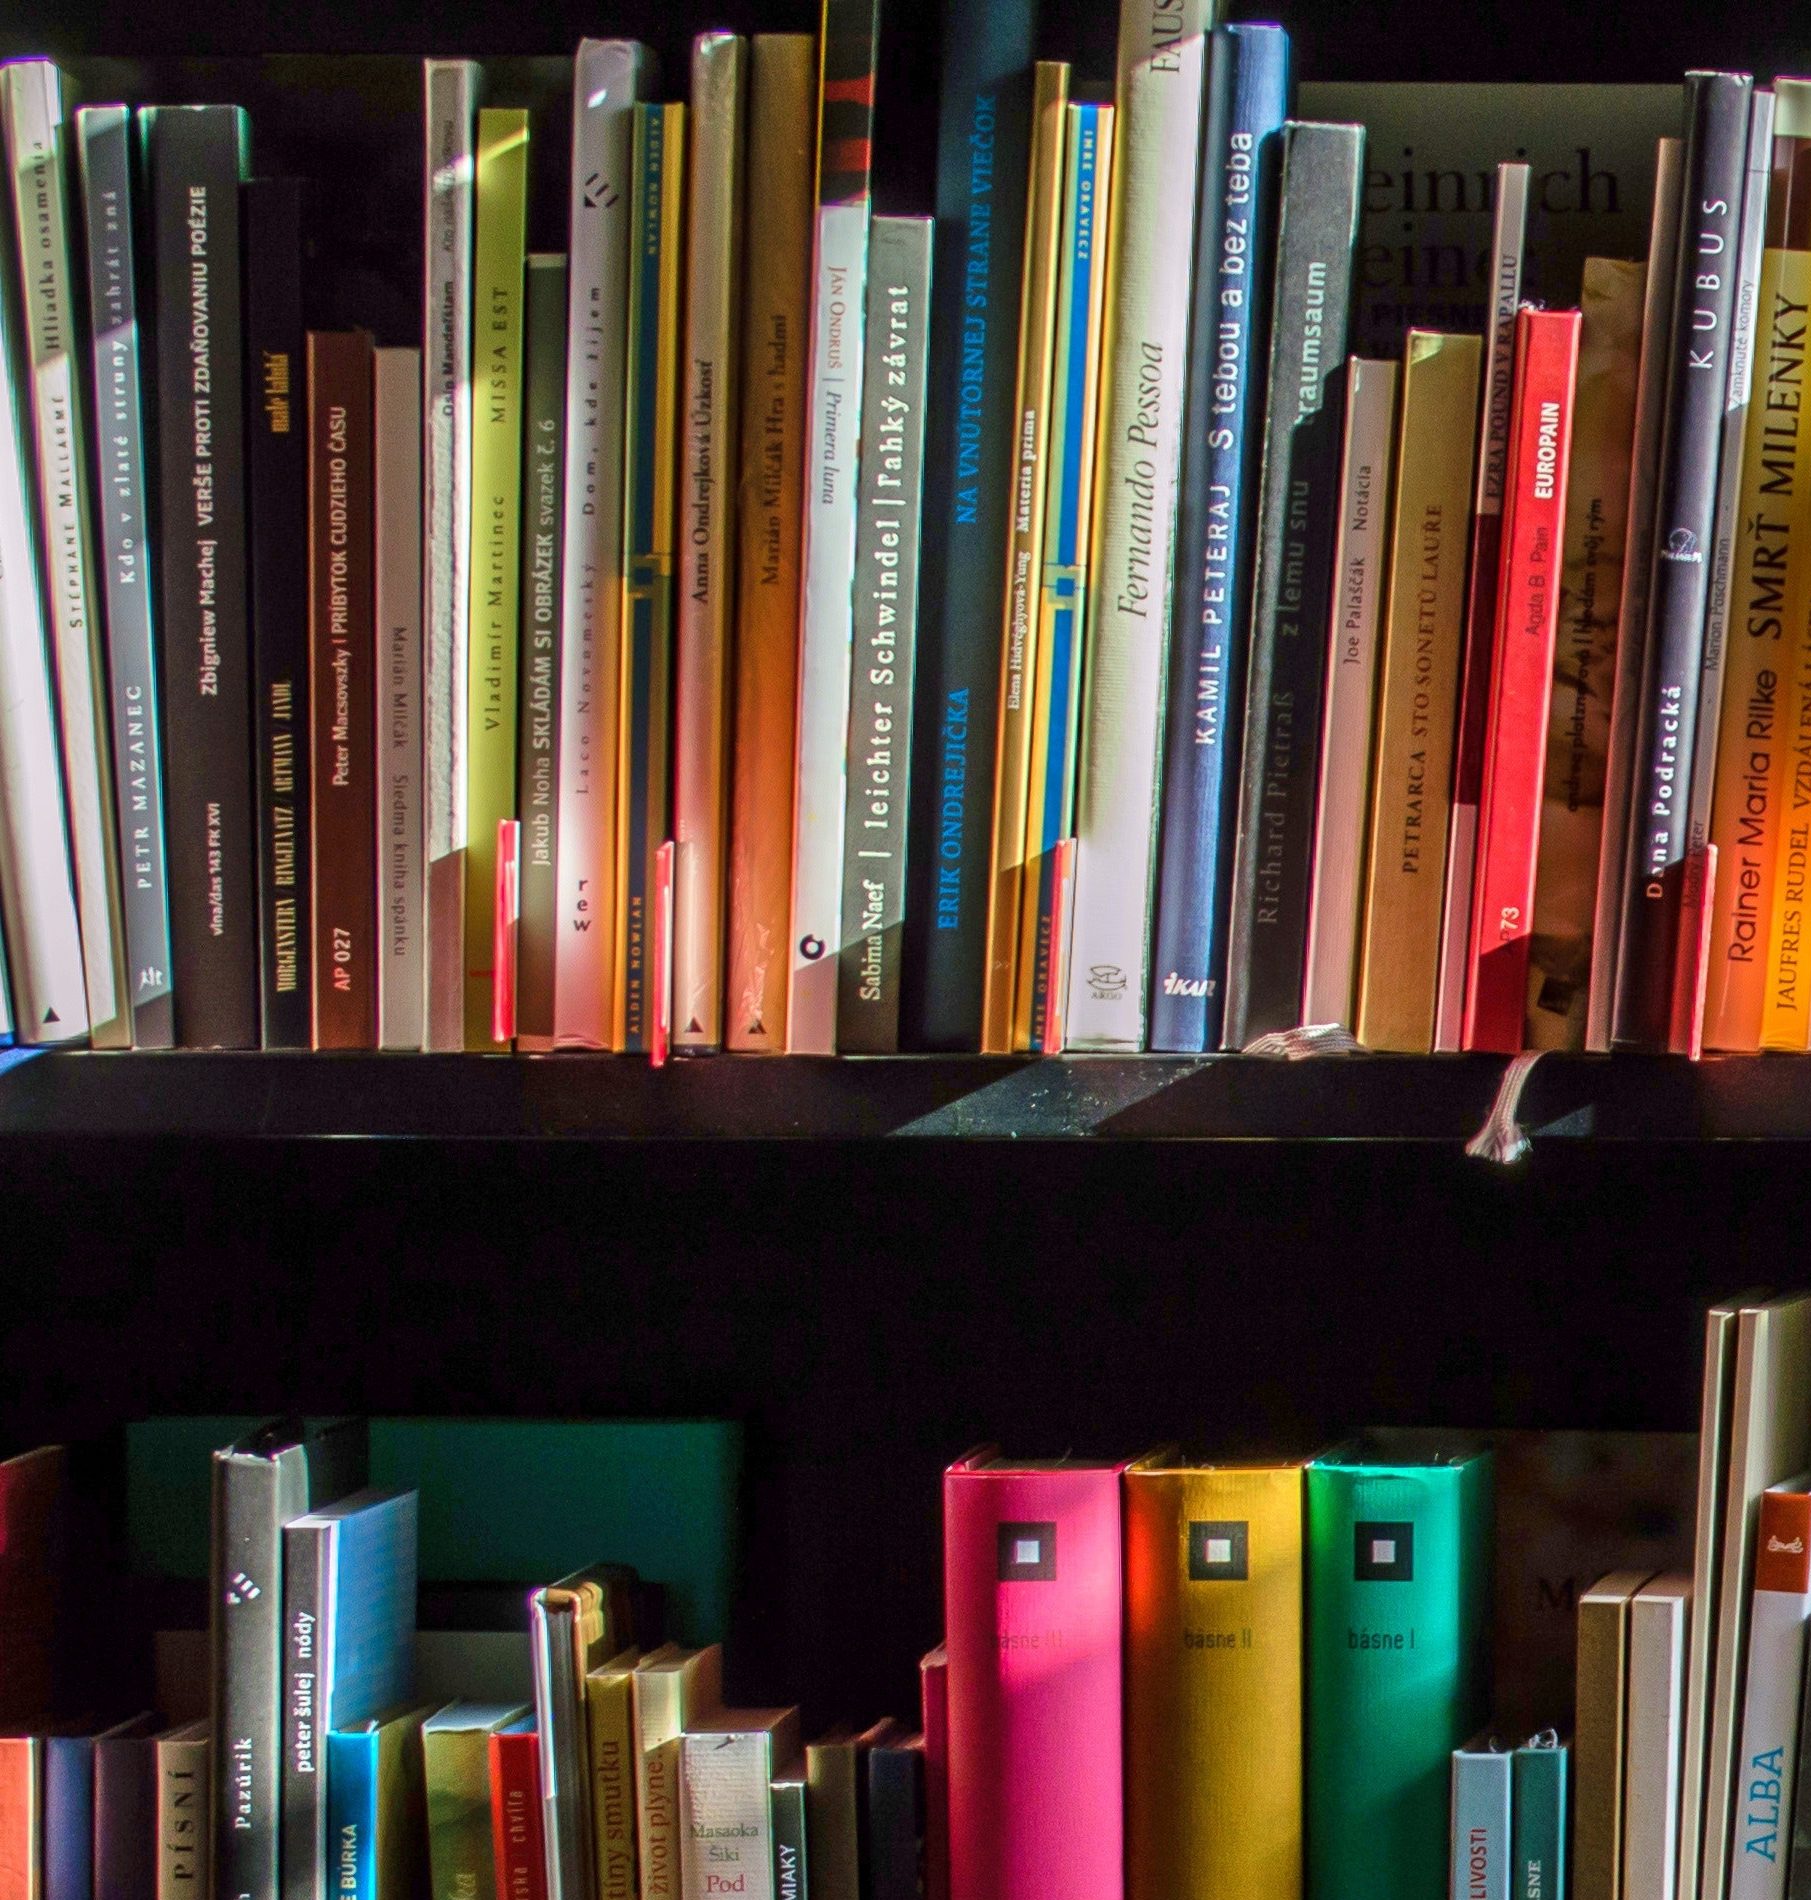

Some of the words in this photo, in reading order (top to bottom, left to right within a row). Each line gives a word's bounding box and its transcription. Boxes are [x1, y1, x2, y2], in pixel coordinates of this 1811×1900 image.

[186, 186, 208, 257] POÉZIE
[187, 263, 211, 393] ZDAŇOVANIU
[1690, 198, 1728, 369] KUBUS
[193, 400, 211, 457] PROTI
[1127, 340, 1164, 448] Pessoa
[1763, 293, 1808, 497] MILENKY
[192, 463, 214, 526] VERŠE
[1534, 402, 1560, 499] EUROPAIN
[196, 540, 219, 606] Machej
[1117, 458, 1158, 619] Fernando
[1199, 484, 1231, 627] PETERAJ
[1746, 513, 1790, 641] SMRŤ
[198, 609, 221, 696] Zbigniew
[1196, 644, 1222, 745] KAMIL
[125, 684, 149, 811] MAZANEC
[134, 827, 153, 889] PETR
[334, 927, 352, 963] 027
[334, 967, 352, 991] AP
[294, 1612, 316, 1658] nódy
[293, 1674, 316, 1717] šulej
[230, 1737, 254, 1830] Pazúrik
[295, 1723, 317, 1773] peter
[165, 1770, 194, 1880] PÍSNÍ
[1744, 1746, 1784, 1862] ALBA
